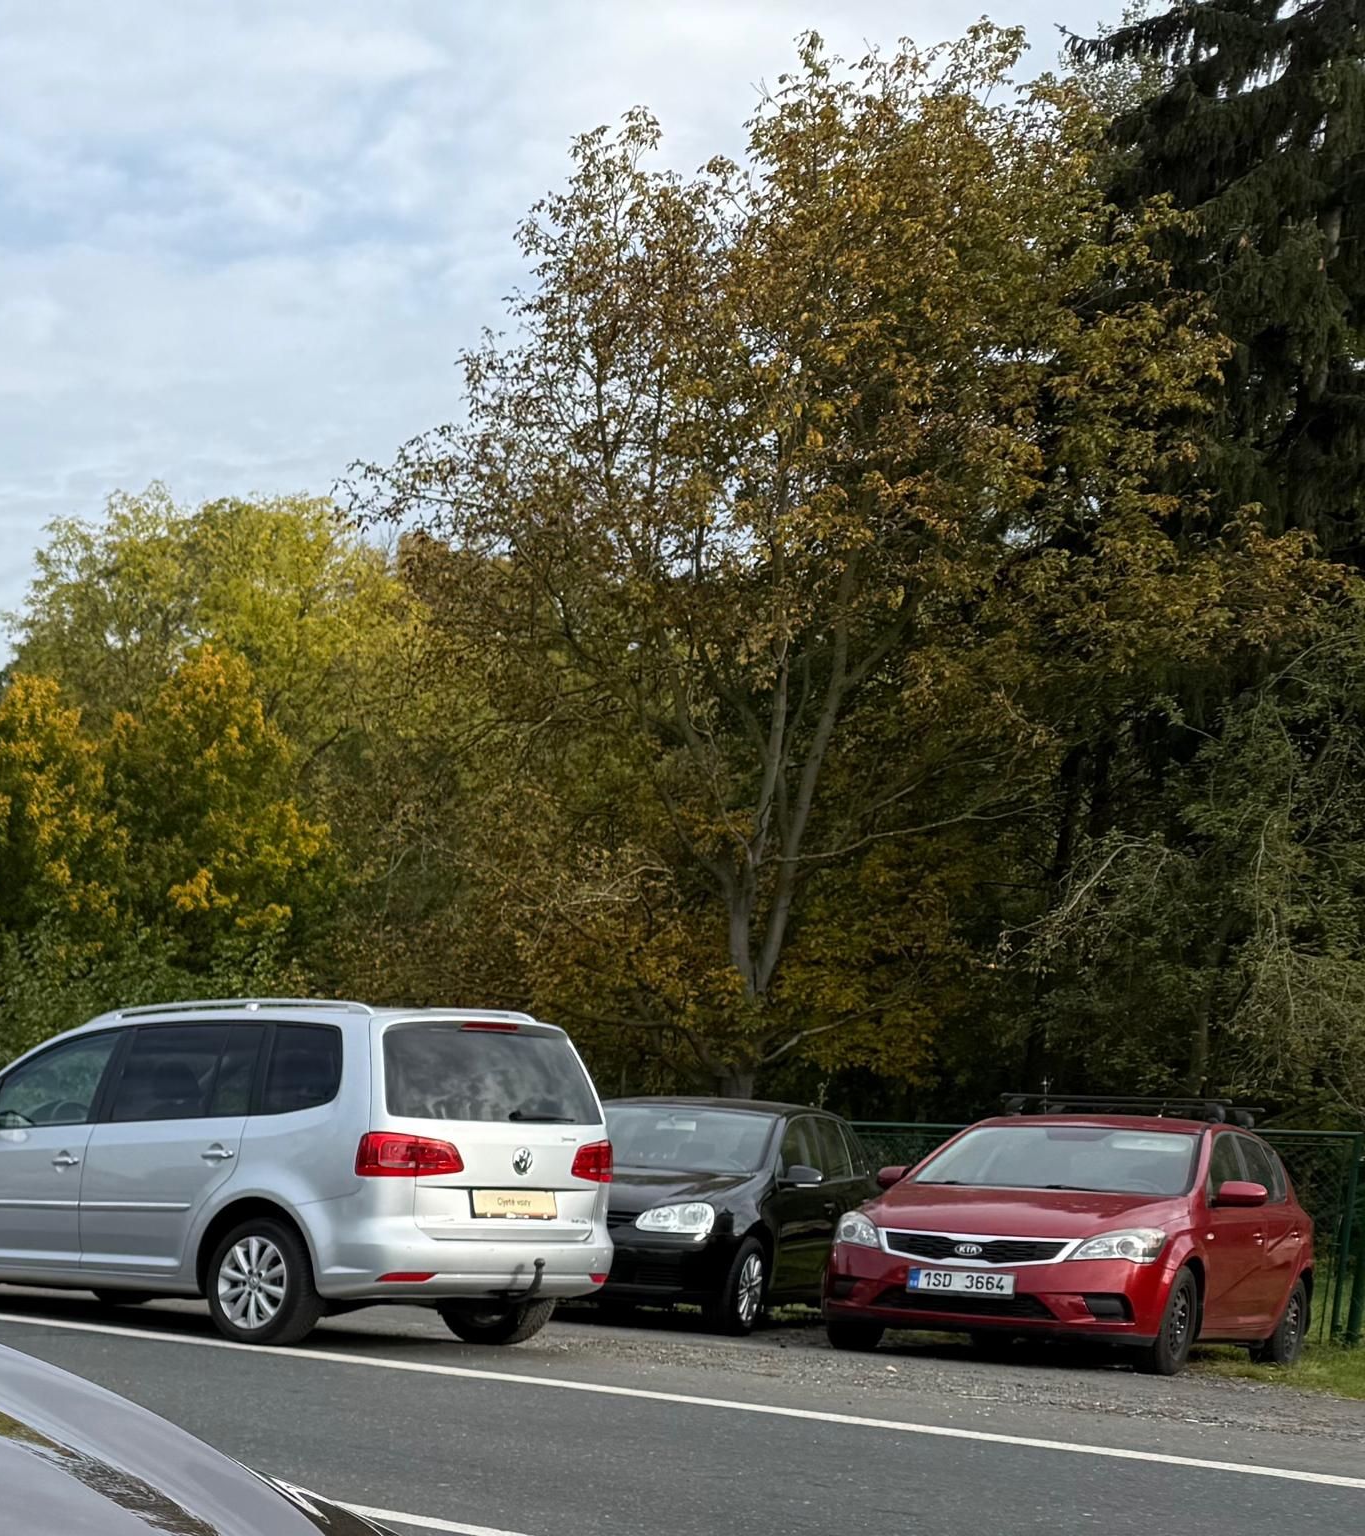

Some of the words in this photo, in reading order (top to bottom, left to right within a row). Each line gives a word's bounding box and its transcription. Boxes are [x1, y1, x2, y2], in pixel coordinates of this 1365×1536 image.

[959, 1245, 977, 1254] KIA
[923, 1271, 953, 1288] 1SD
[964, 1274, 1005, 1292] 3664
